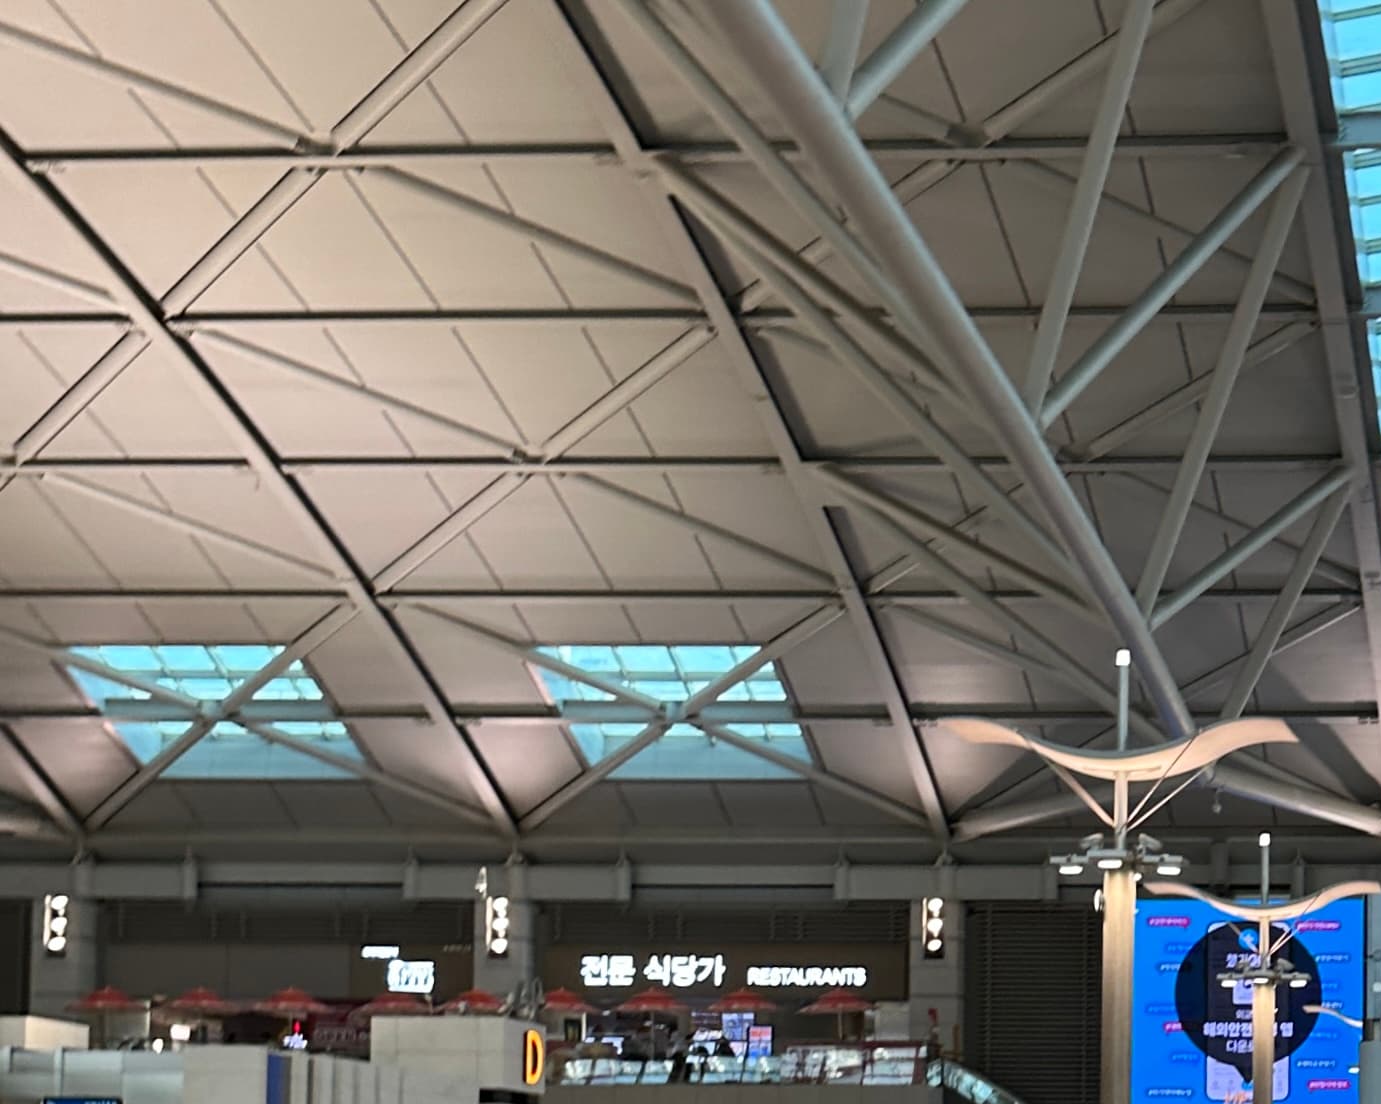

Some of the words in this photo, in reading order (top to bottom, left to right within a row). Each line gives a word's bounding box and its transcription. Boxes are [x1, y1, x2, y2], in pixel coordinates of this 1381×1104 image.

[580, 954, 636, 986] 전문
[643, 954, 726, 986] 식당가
[746, 967, 867, 986] RESTAURANTS
[524, 1029, 545, 1085] D
